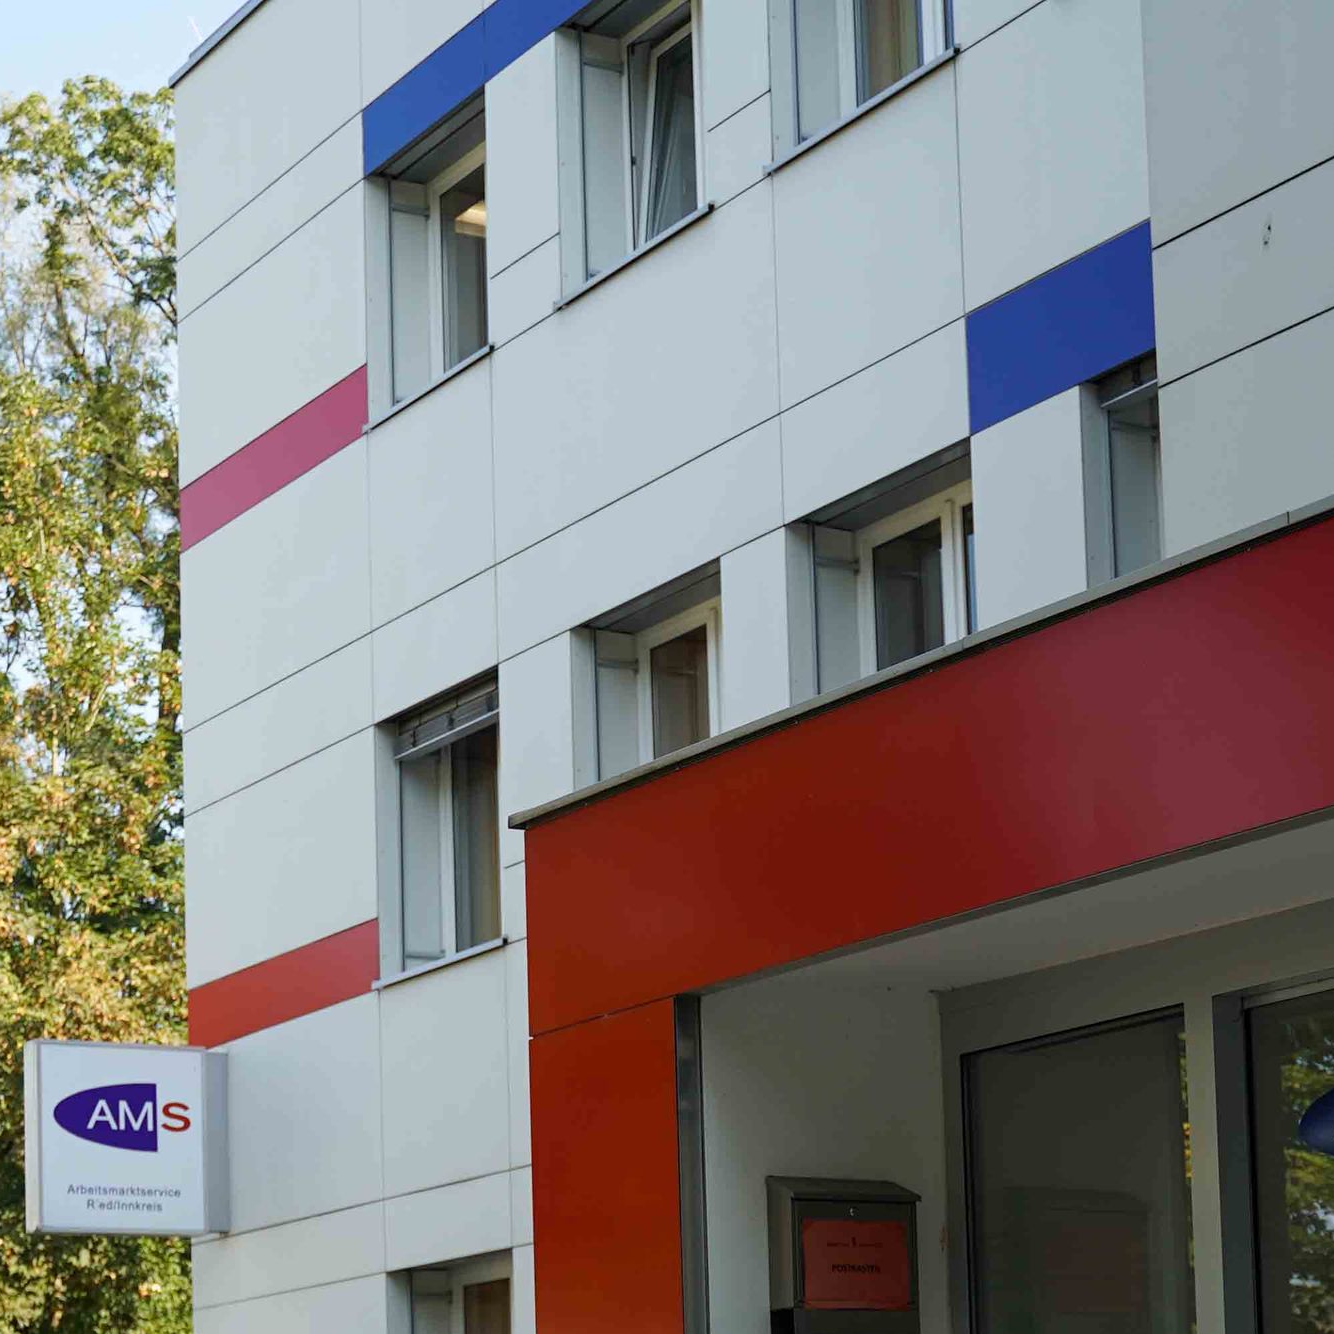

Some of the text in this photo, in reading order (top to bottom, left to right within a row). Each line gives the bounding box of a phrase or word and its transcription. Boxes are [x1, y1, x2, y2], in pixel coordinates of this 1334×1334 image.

[87, 1098, 191, 1132] AMS
[67, 1184, 181, 1198] Arbeitsmarktservice
[87, 1199, 163, 1212] Red/Innkreis
